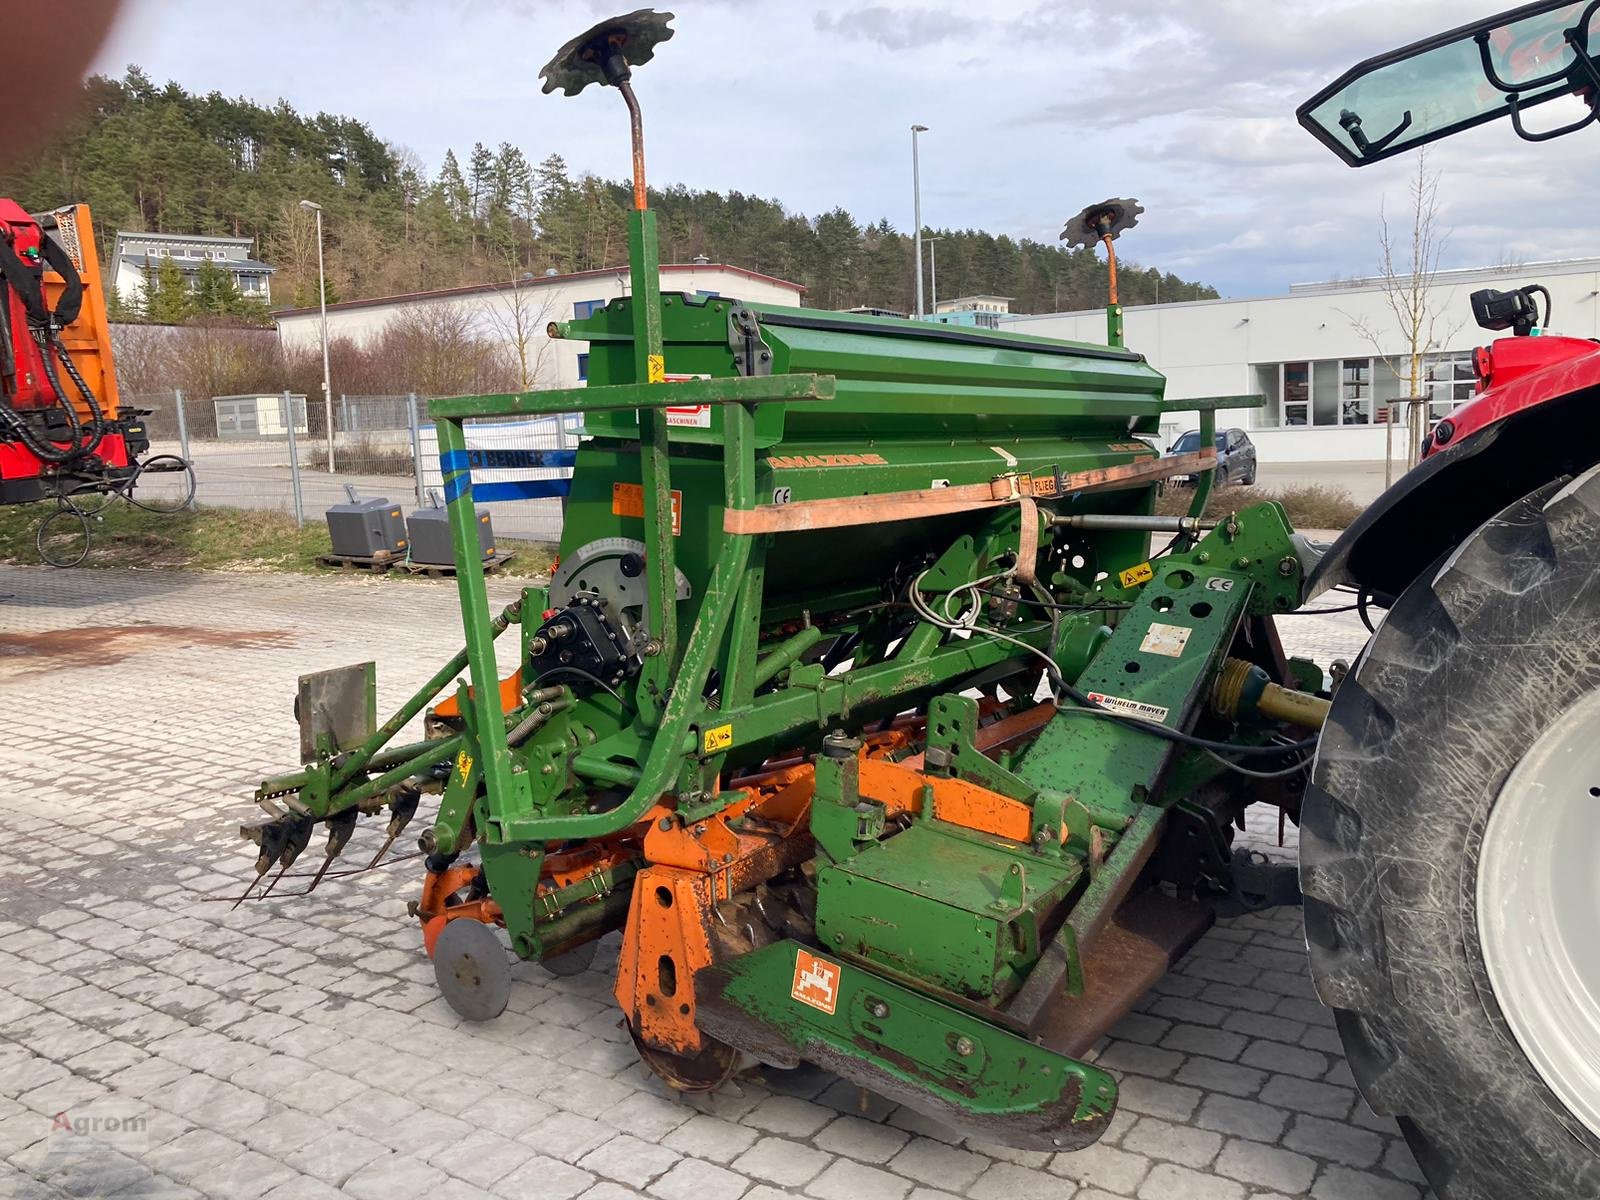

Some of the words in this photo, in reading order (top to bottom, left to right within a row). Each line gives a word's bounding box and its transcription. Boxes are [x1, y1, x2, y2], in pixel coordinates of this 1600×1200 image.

[486, 450, 544, 467] BERNER
[767, 454, 888, 469] AMAZONE
[1208, 579, 1233, 591] CE
[1104, 697, 1138, 709] WILHELM
[1138, 704, 1166, 716] MAYER
